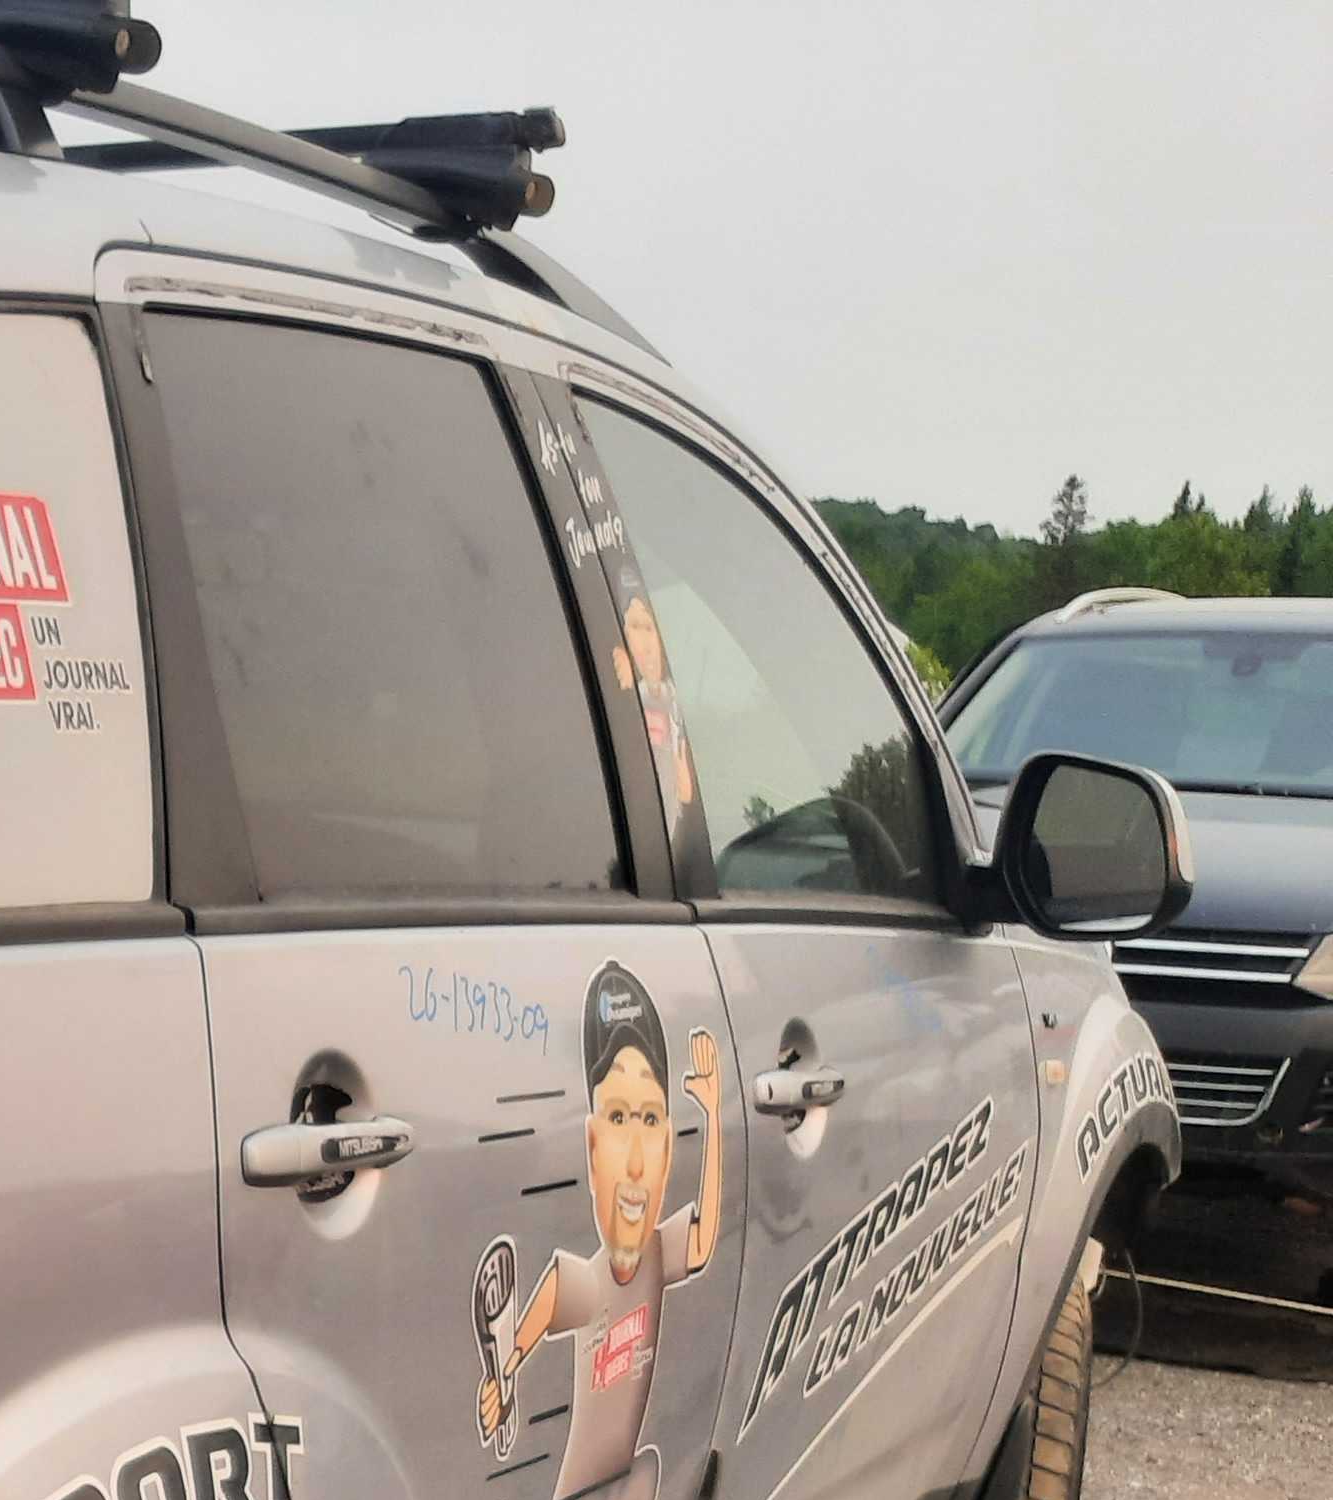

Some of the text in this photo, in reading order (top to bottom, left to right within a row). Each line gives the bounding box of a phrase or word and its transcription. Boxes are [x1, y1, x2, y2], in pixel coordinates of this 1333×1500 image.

[32, 617, 62, 646] UN
[44, 661, 130, 691] JOURNAL
[49, 701, 101, 730] VRAI.
[742, 1098, 992, 1435] ATTRAPEZ
[805, 1307, 860, 1393] LA
[860, 1146, 1027, 1346] NOUVELLE!
